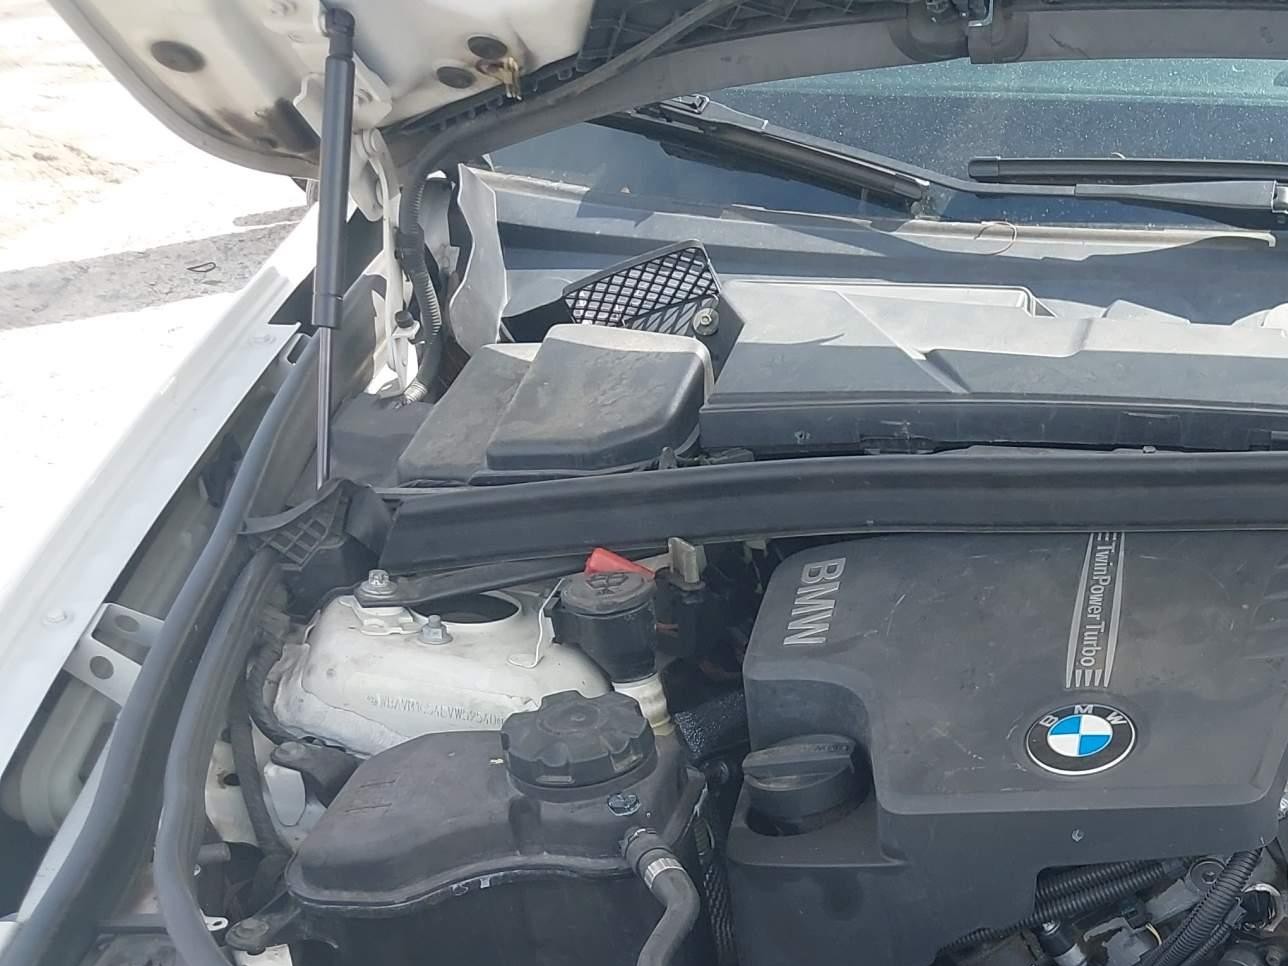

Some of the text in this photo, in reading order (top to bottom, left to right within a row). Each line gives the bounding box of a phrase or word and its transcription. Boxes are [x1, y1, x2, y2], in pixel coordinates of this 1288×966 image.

[783, 557, 847, 645] BMW
[1080, 541, 1116, 667] TwinPower Turbo
[1039, 704, 1128, 728] BMW
